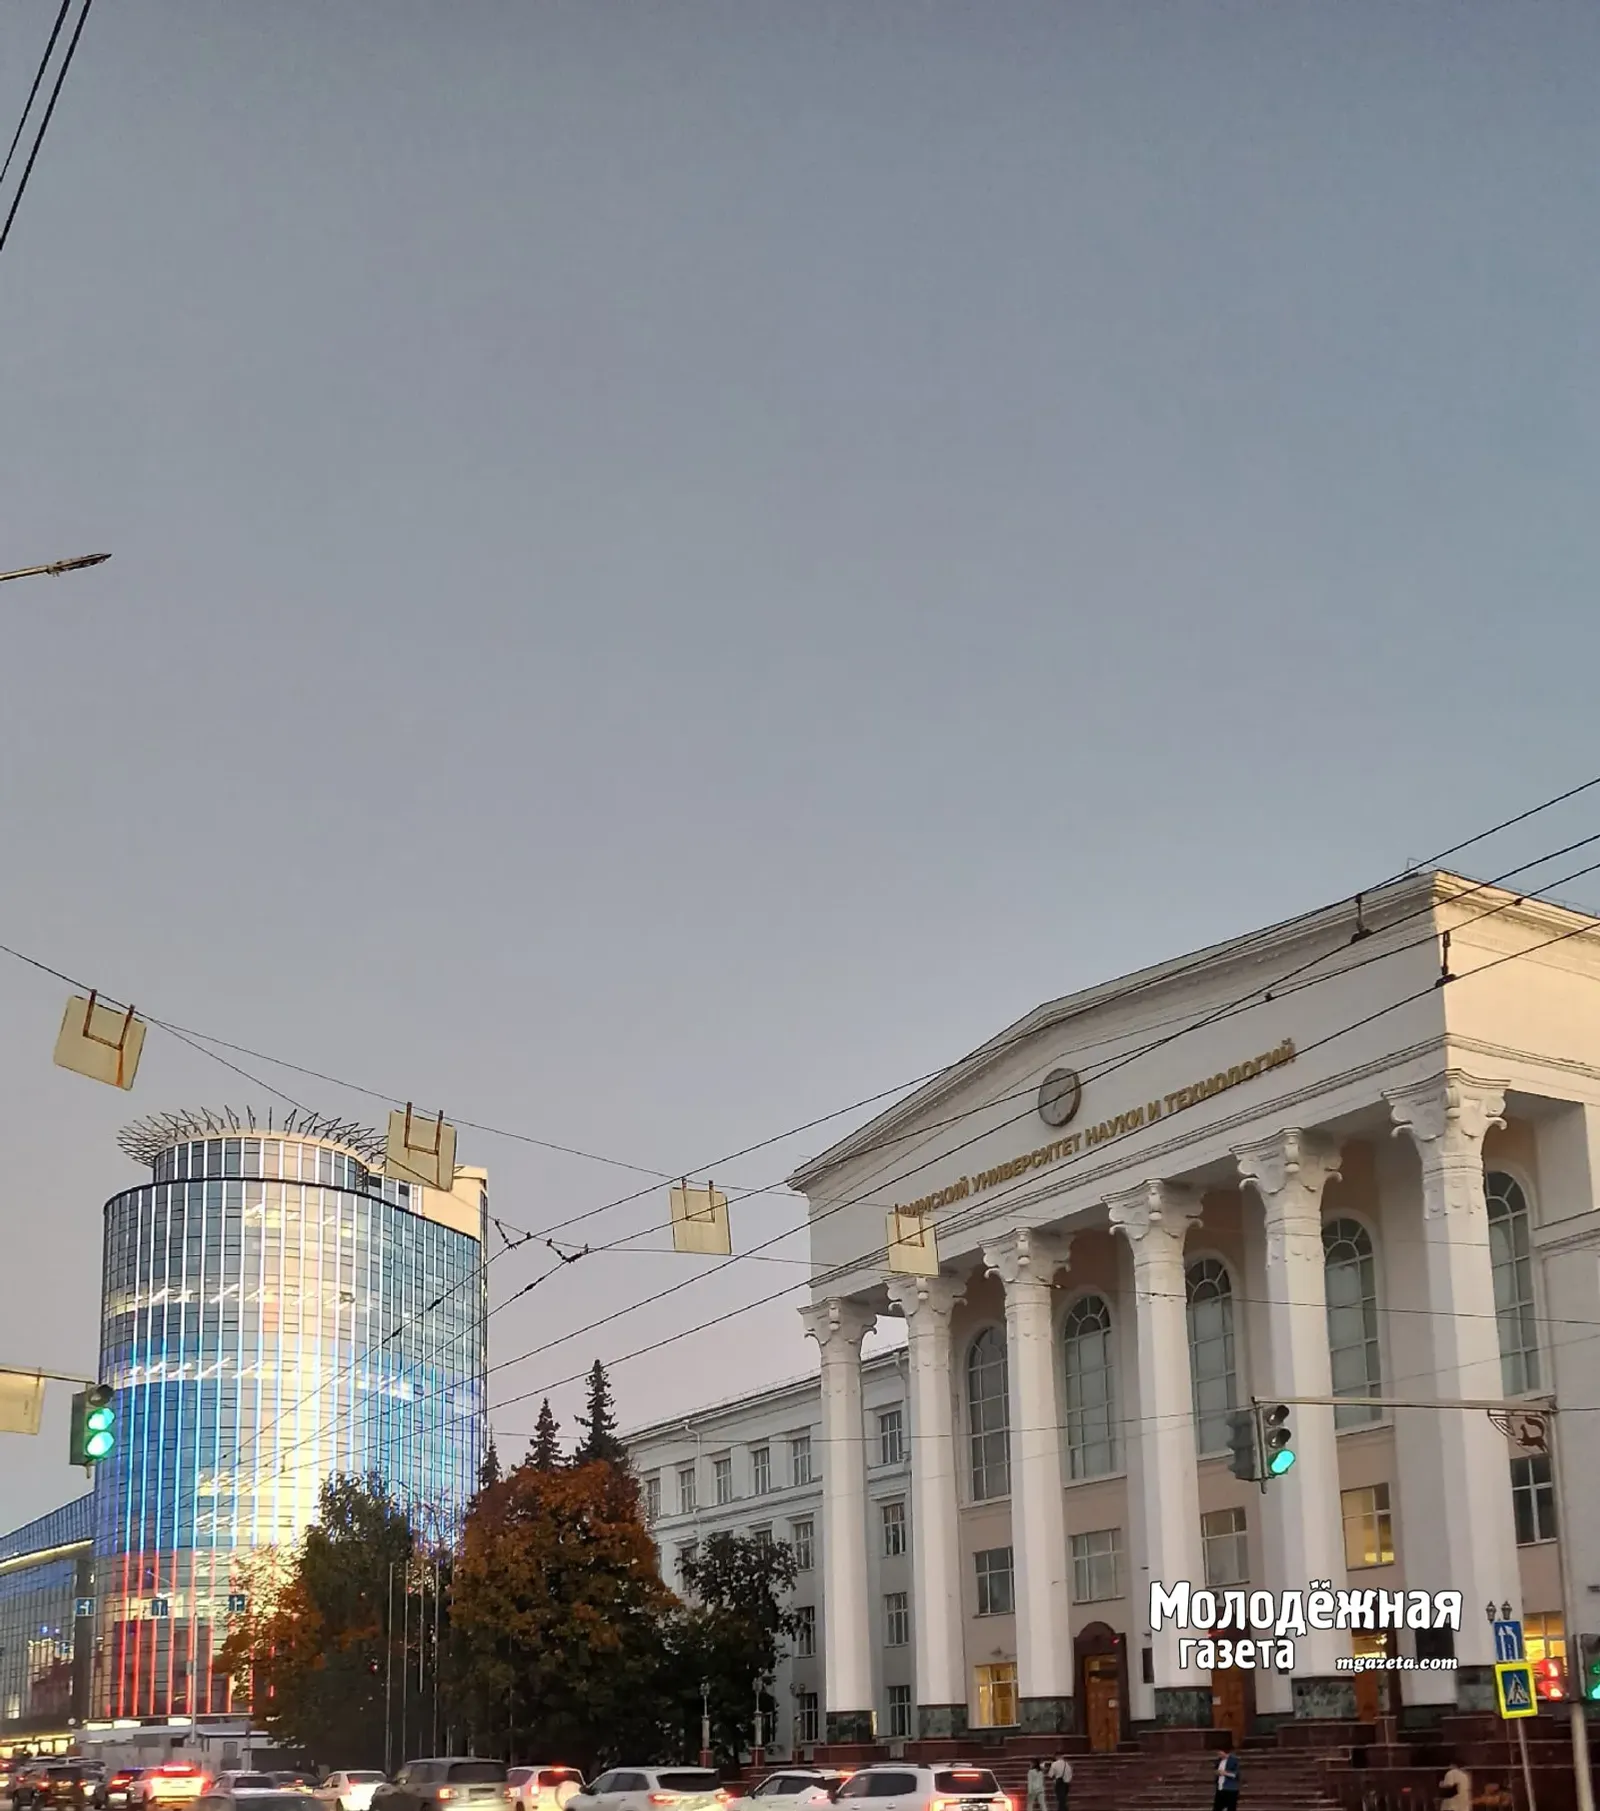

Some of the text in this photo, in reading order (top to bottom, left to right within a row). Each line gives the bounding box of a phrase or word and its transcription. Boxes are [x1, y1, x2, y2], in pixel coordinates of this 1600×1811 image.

[889, 1037, 1296, 1216] ФИМСКИЙ УНИВЕРСИТЕТ НАУКИ И ТЕХНОЛОГИЙ
